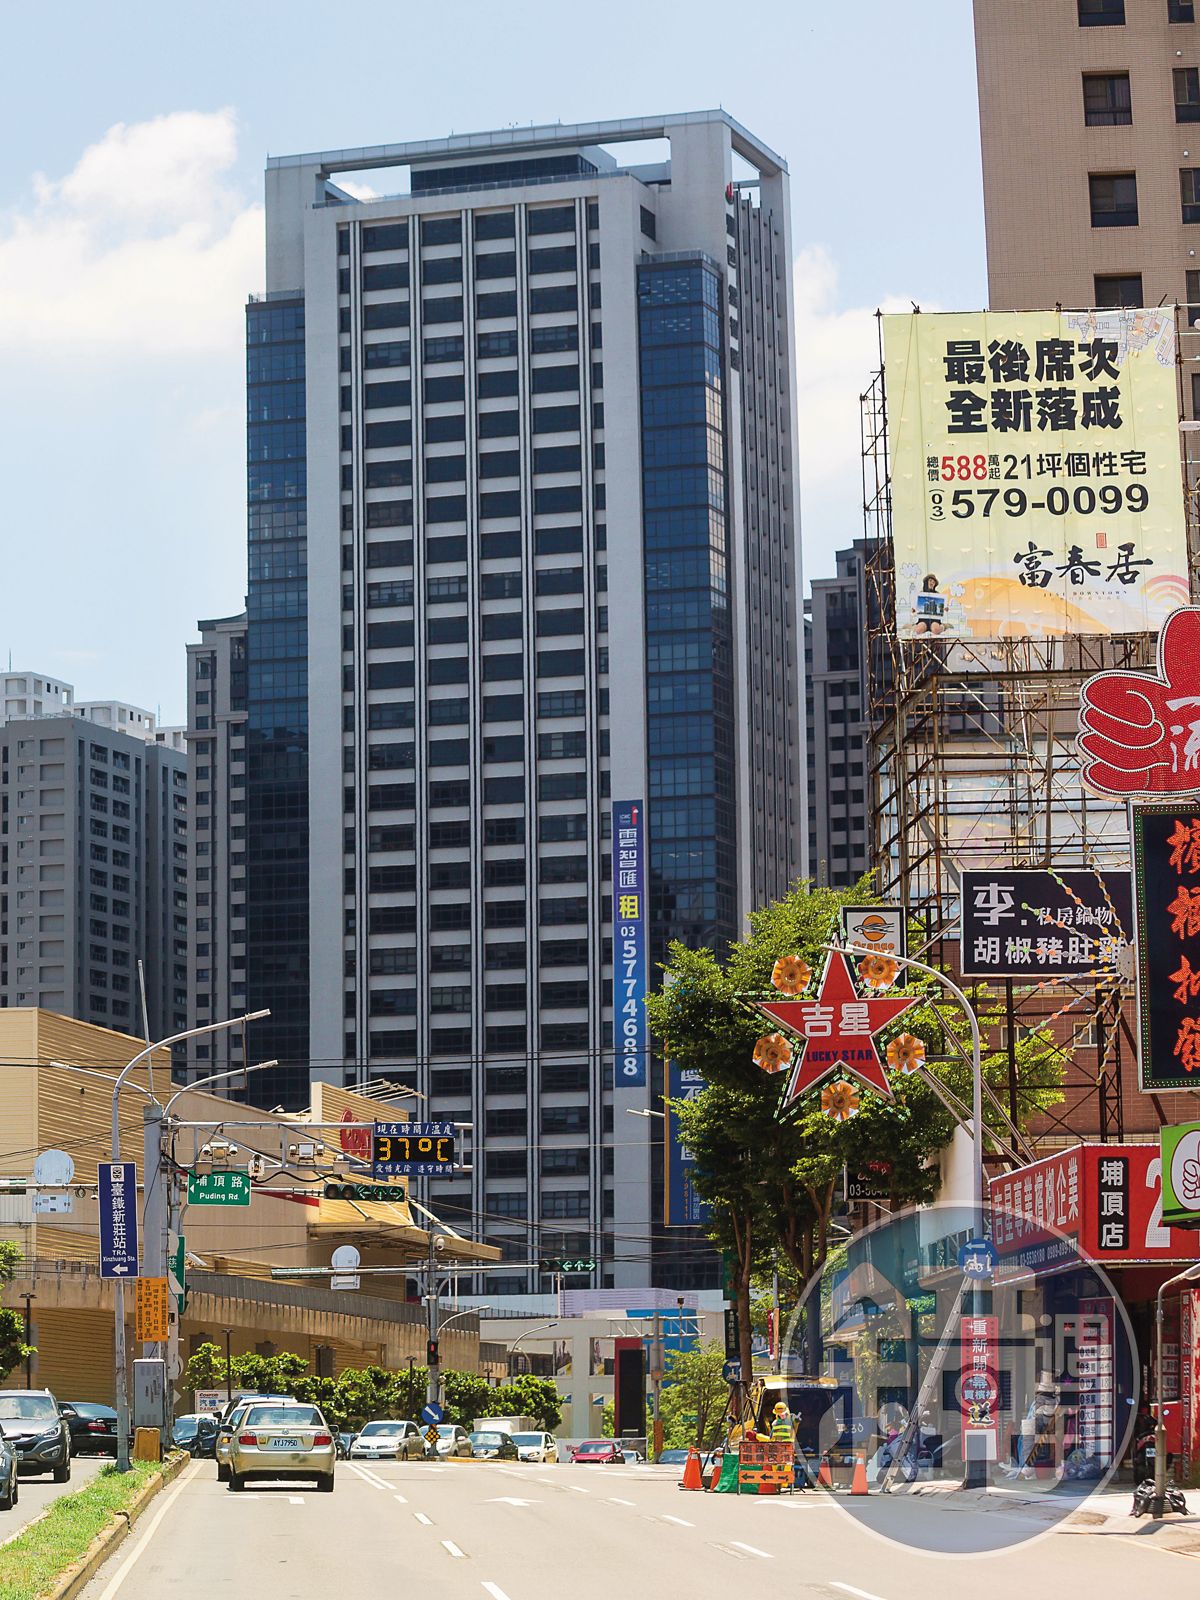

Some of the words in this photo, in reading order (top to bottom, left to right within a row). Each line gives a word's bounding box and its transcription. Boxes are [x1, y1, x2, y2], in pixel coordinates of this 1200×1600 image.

[943, 338, 1121, 385] 最後席次
[945, 386, 1123, 434] 全新落成
[927, 456, 940, 483] 總價
[941, 455, 987, 481] 588
[988, 454, 1000, 480] 萬起
[1004, 450, 1147, 480] 21坪個性宅
[951, 484, 1149, 518] 579-0099
[1013, 541, 1154, 588] 富春居
[619, 828, 637, 888] 雲智匯
[619, 895, 639, 919] 租
[620, 927, 636, 937] 03
[622, 940, 638, 1076] 5774688
[801, 1002, 872, 1037] 吉星
[806, 1051, 838, 1062] LUCKY
[842, 1050, 873, 1061] STAR
[377, 1124, 453, 1136] 現在時間/溫度
[196, 1174, 243, 1188] 埔頂路
[200, 1192, 226, 1201] Puding
[111, 1183, 127, 1249] 臺鐵新莊站
[1101, 1160, 1125, 1248] 埔頂店
[972, 1320, 988, 1389] 重新開幕
